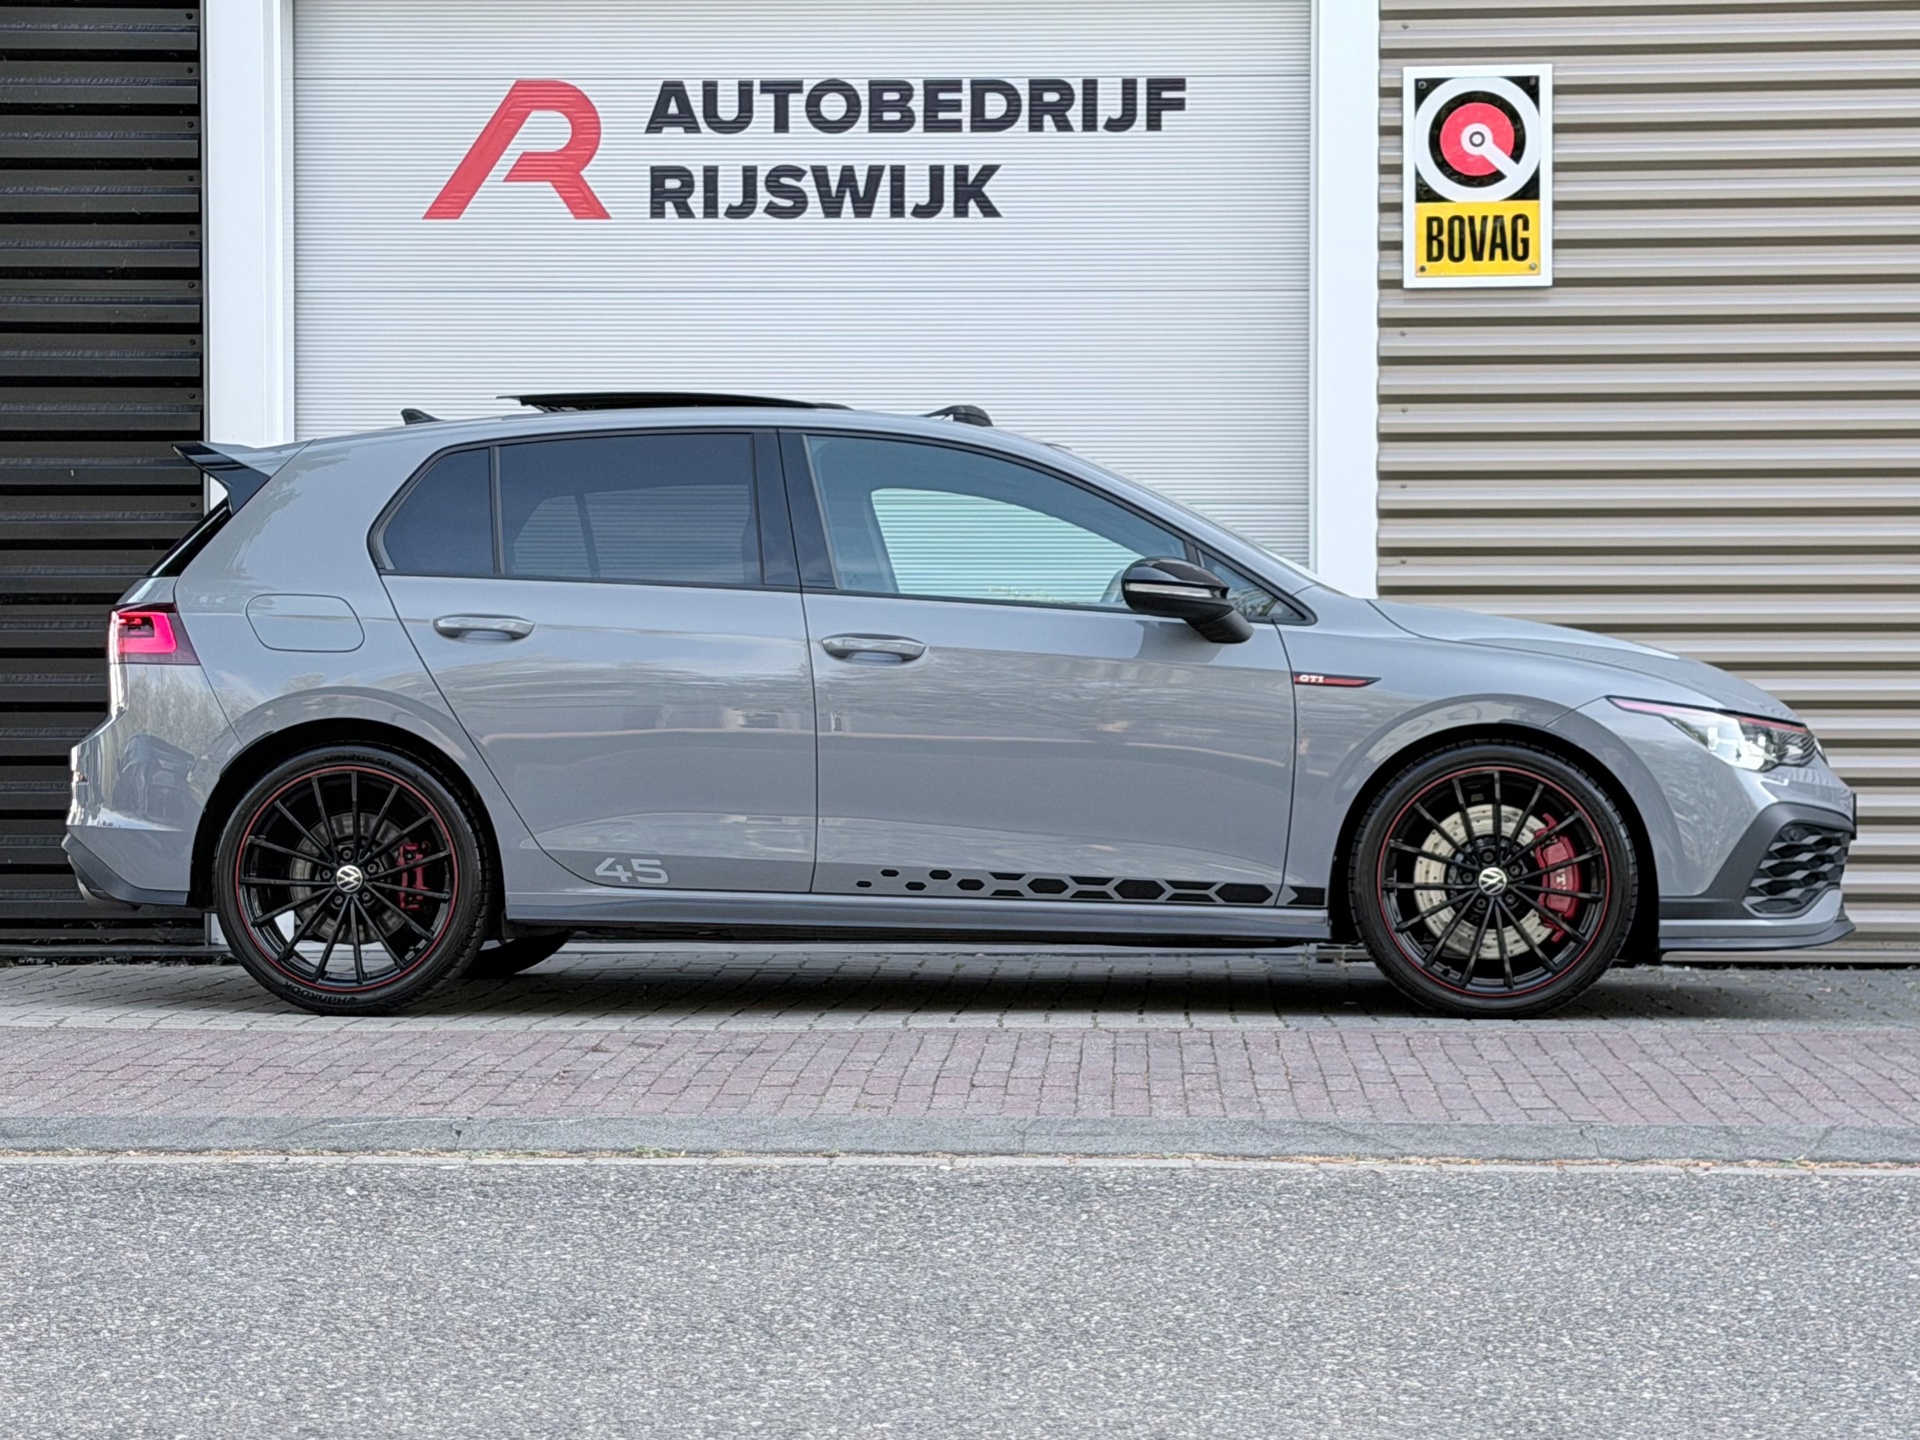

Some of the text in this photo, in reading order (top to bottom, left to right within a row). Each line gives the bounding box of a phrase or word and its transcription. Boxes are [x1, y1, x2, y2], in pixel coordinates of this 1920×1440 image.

[644, 77, 1187, 134] AUTOBEDRIJF
[649, 164, 1003, 220] RIJSWIJK
[1426, 213, 1530, 263] BOVAG
[1298, 674, 1325, 683] GTI
[594, 857, 669, 884] 45
